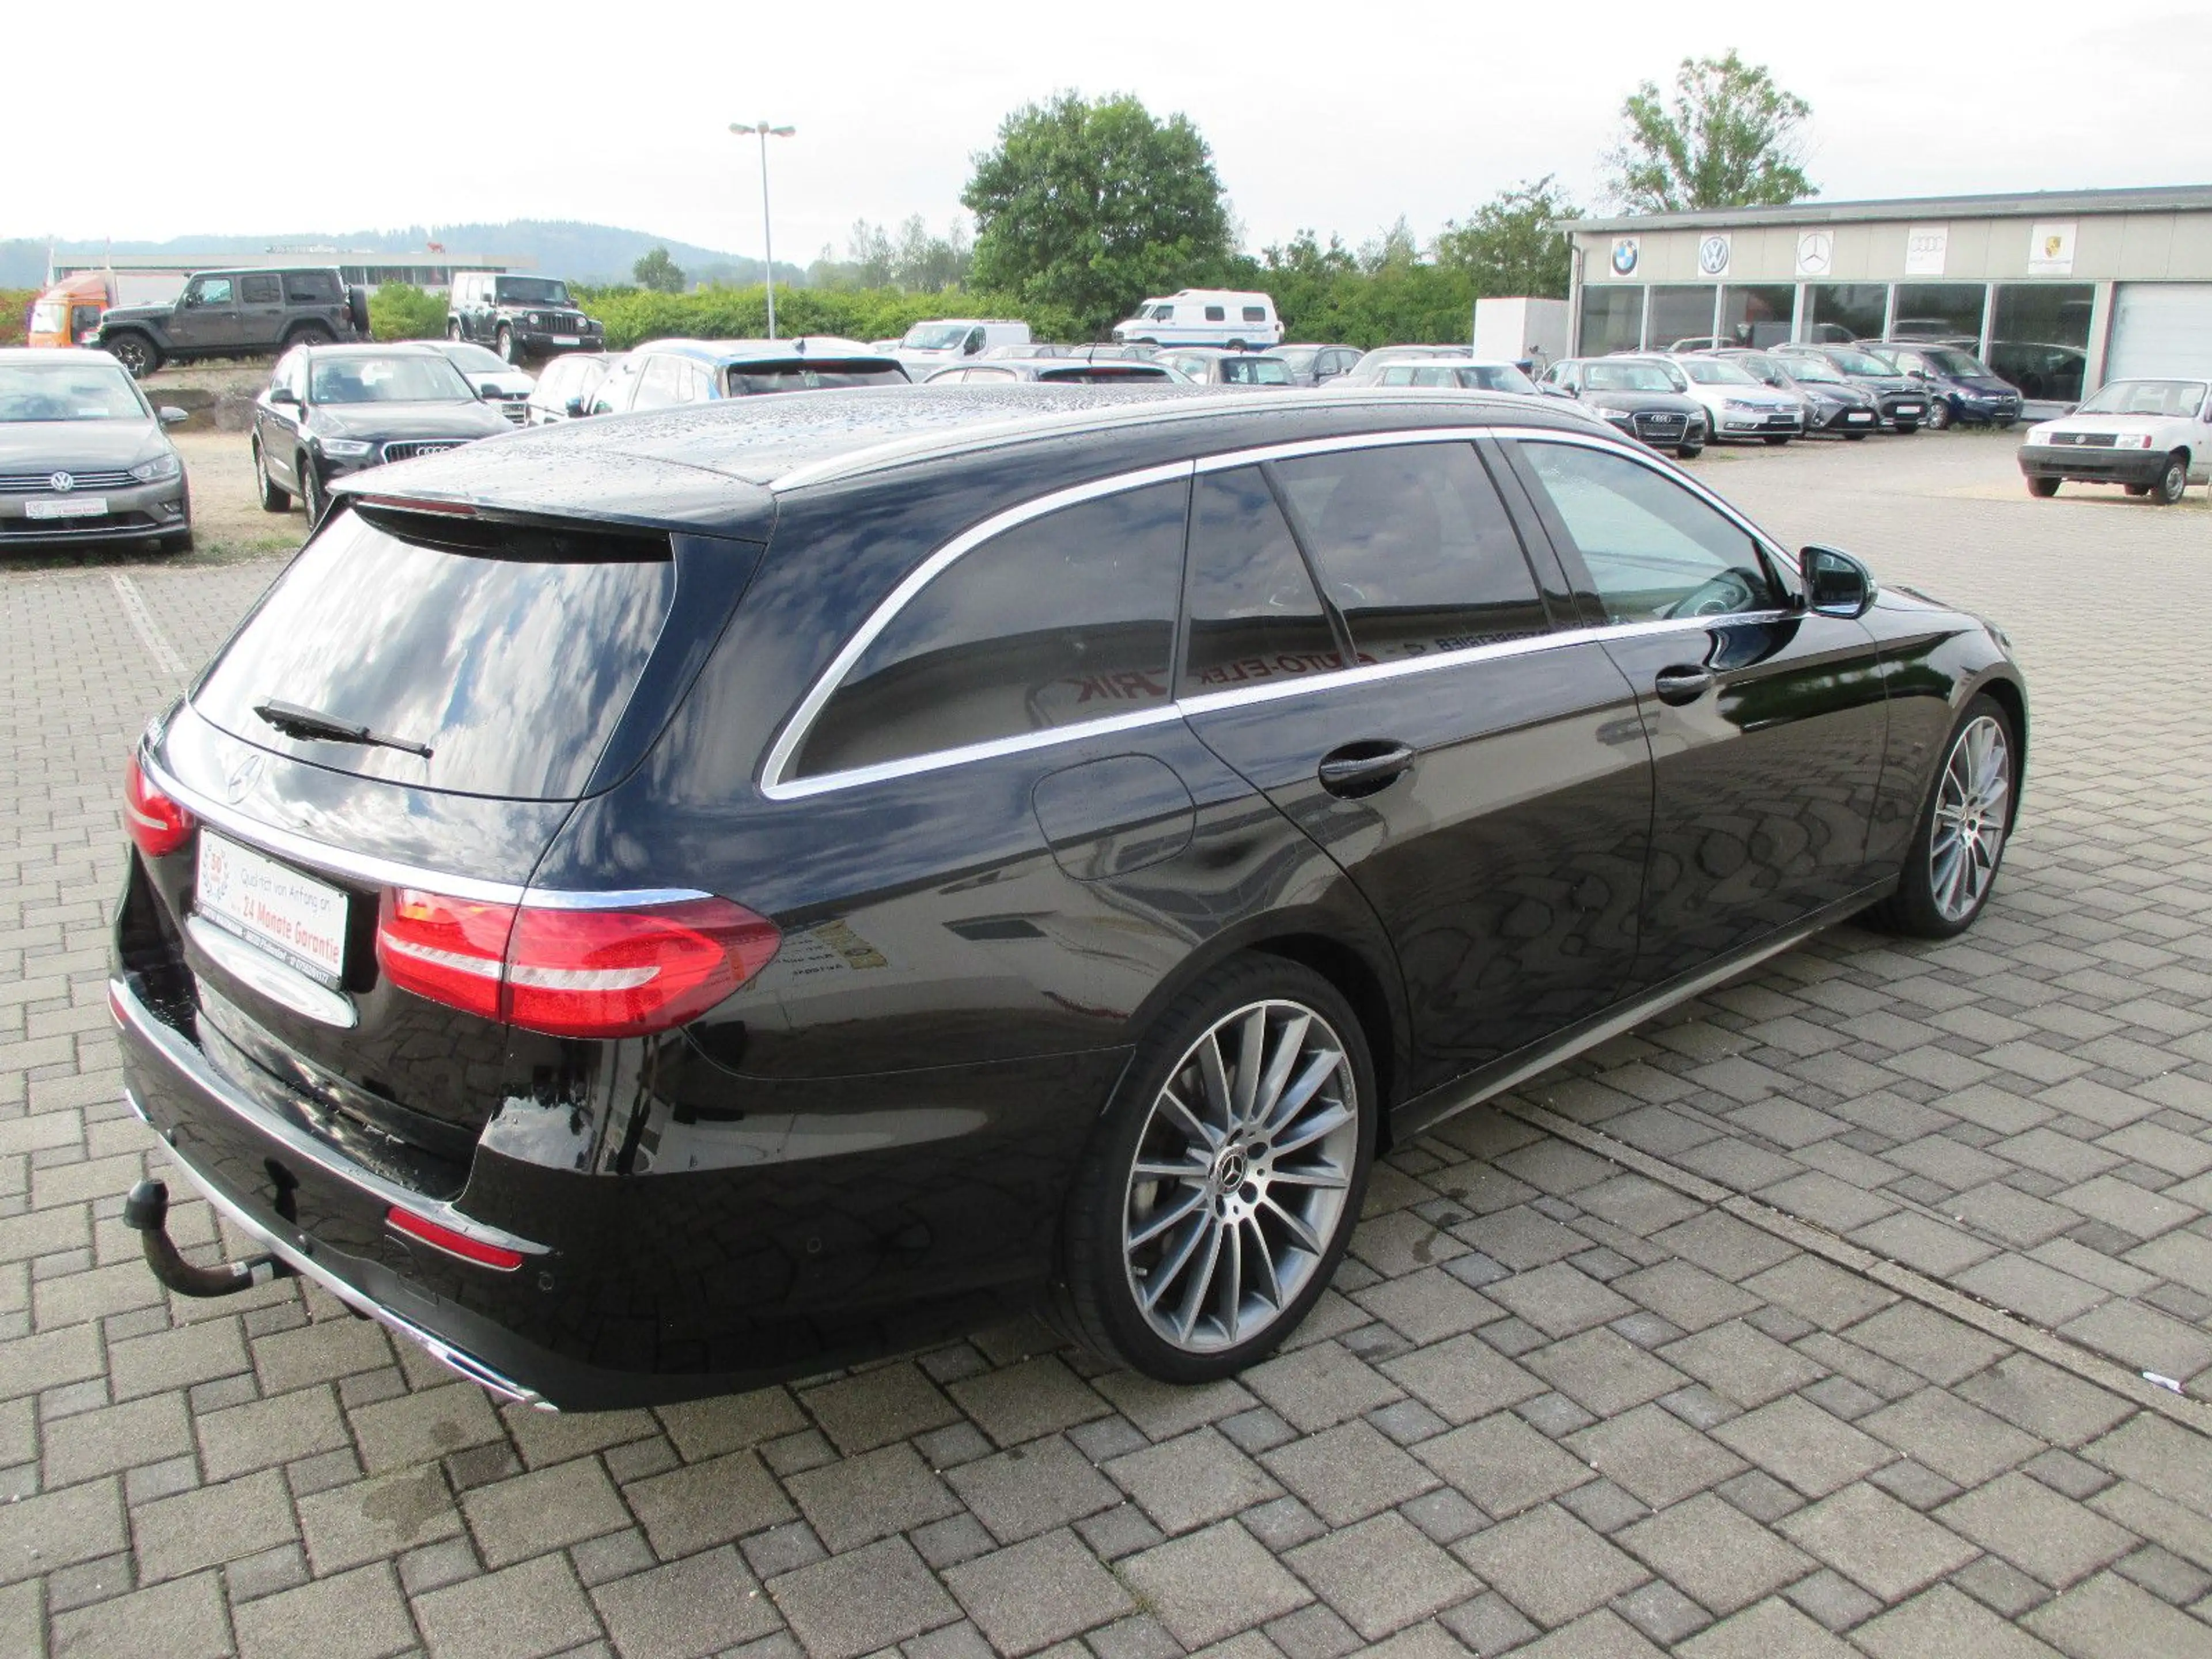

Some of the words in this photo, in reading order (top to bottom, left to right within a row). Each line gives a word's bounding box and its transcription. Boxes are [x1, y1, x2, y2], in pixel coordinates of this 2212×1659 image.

[289, 884, 317, 911] Anfang
[243, 895, 255, 919] 24
[257, 900, 291, 939] Monate
[295, 920, 339, 964] Garantie
